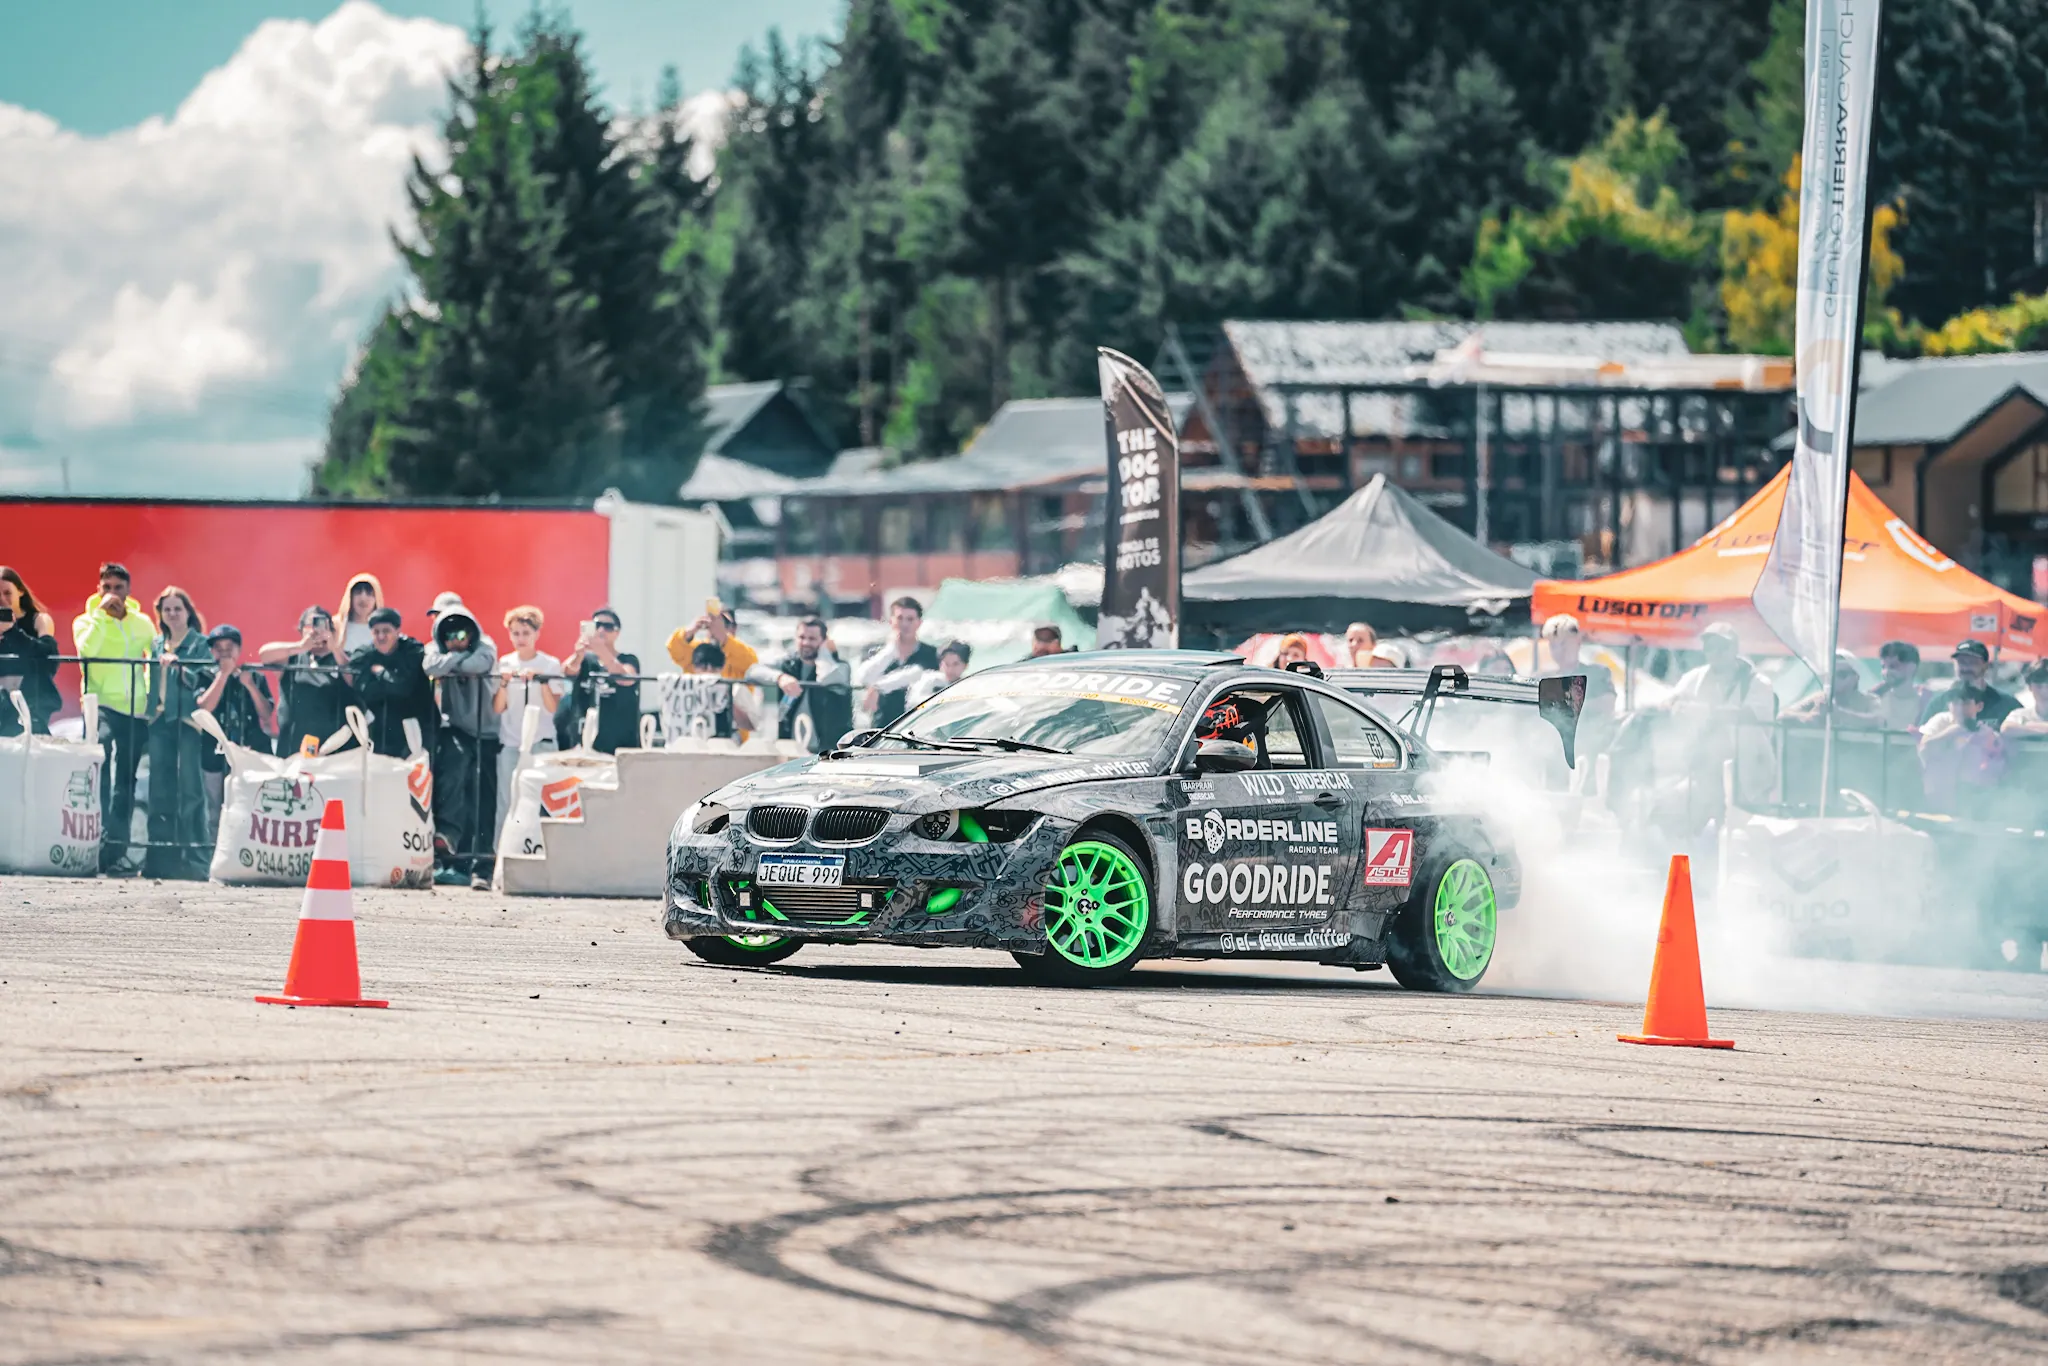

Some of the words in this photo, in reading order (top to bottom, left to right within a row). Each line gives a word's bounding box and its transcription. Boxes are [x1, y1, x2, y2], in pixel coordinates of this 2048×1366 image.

[1117, 427, 1157, 454] THE
[1118, 450, 1160, 483] DOC
[1120, 476, 1161, 507] TOR
[1239, 774, 1286, 797] WILD
[1287, 772, 1354, 790] UNDERCAR
[1288, 845, 1317, 854] RACING
[1319, 846, 1339, 855] TEAM
[760, 865, 807, 883] JEQUE
[812, 867, 840, 885] 999
[1183, 862, 1332, 905] GOODRIDE
[1368, 866, 1410, 877] ASTUS
